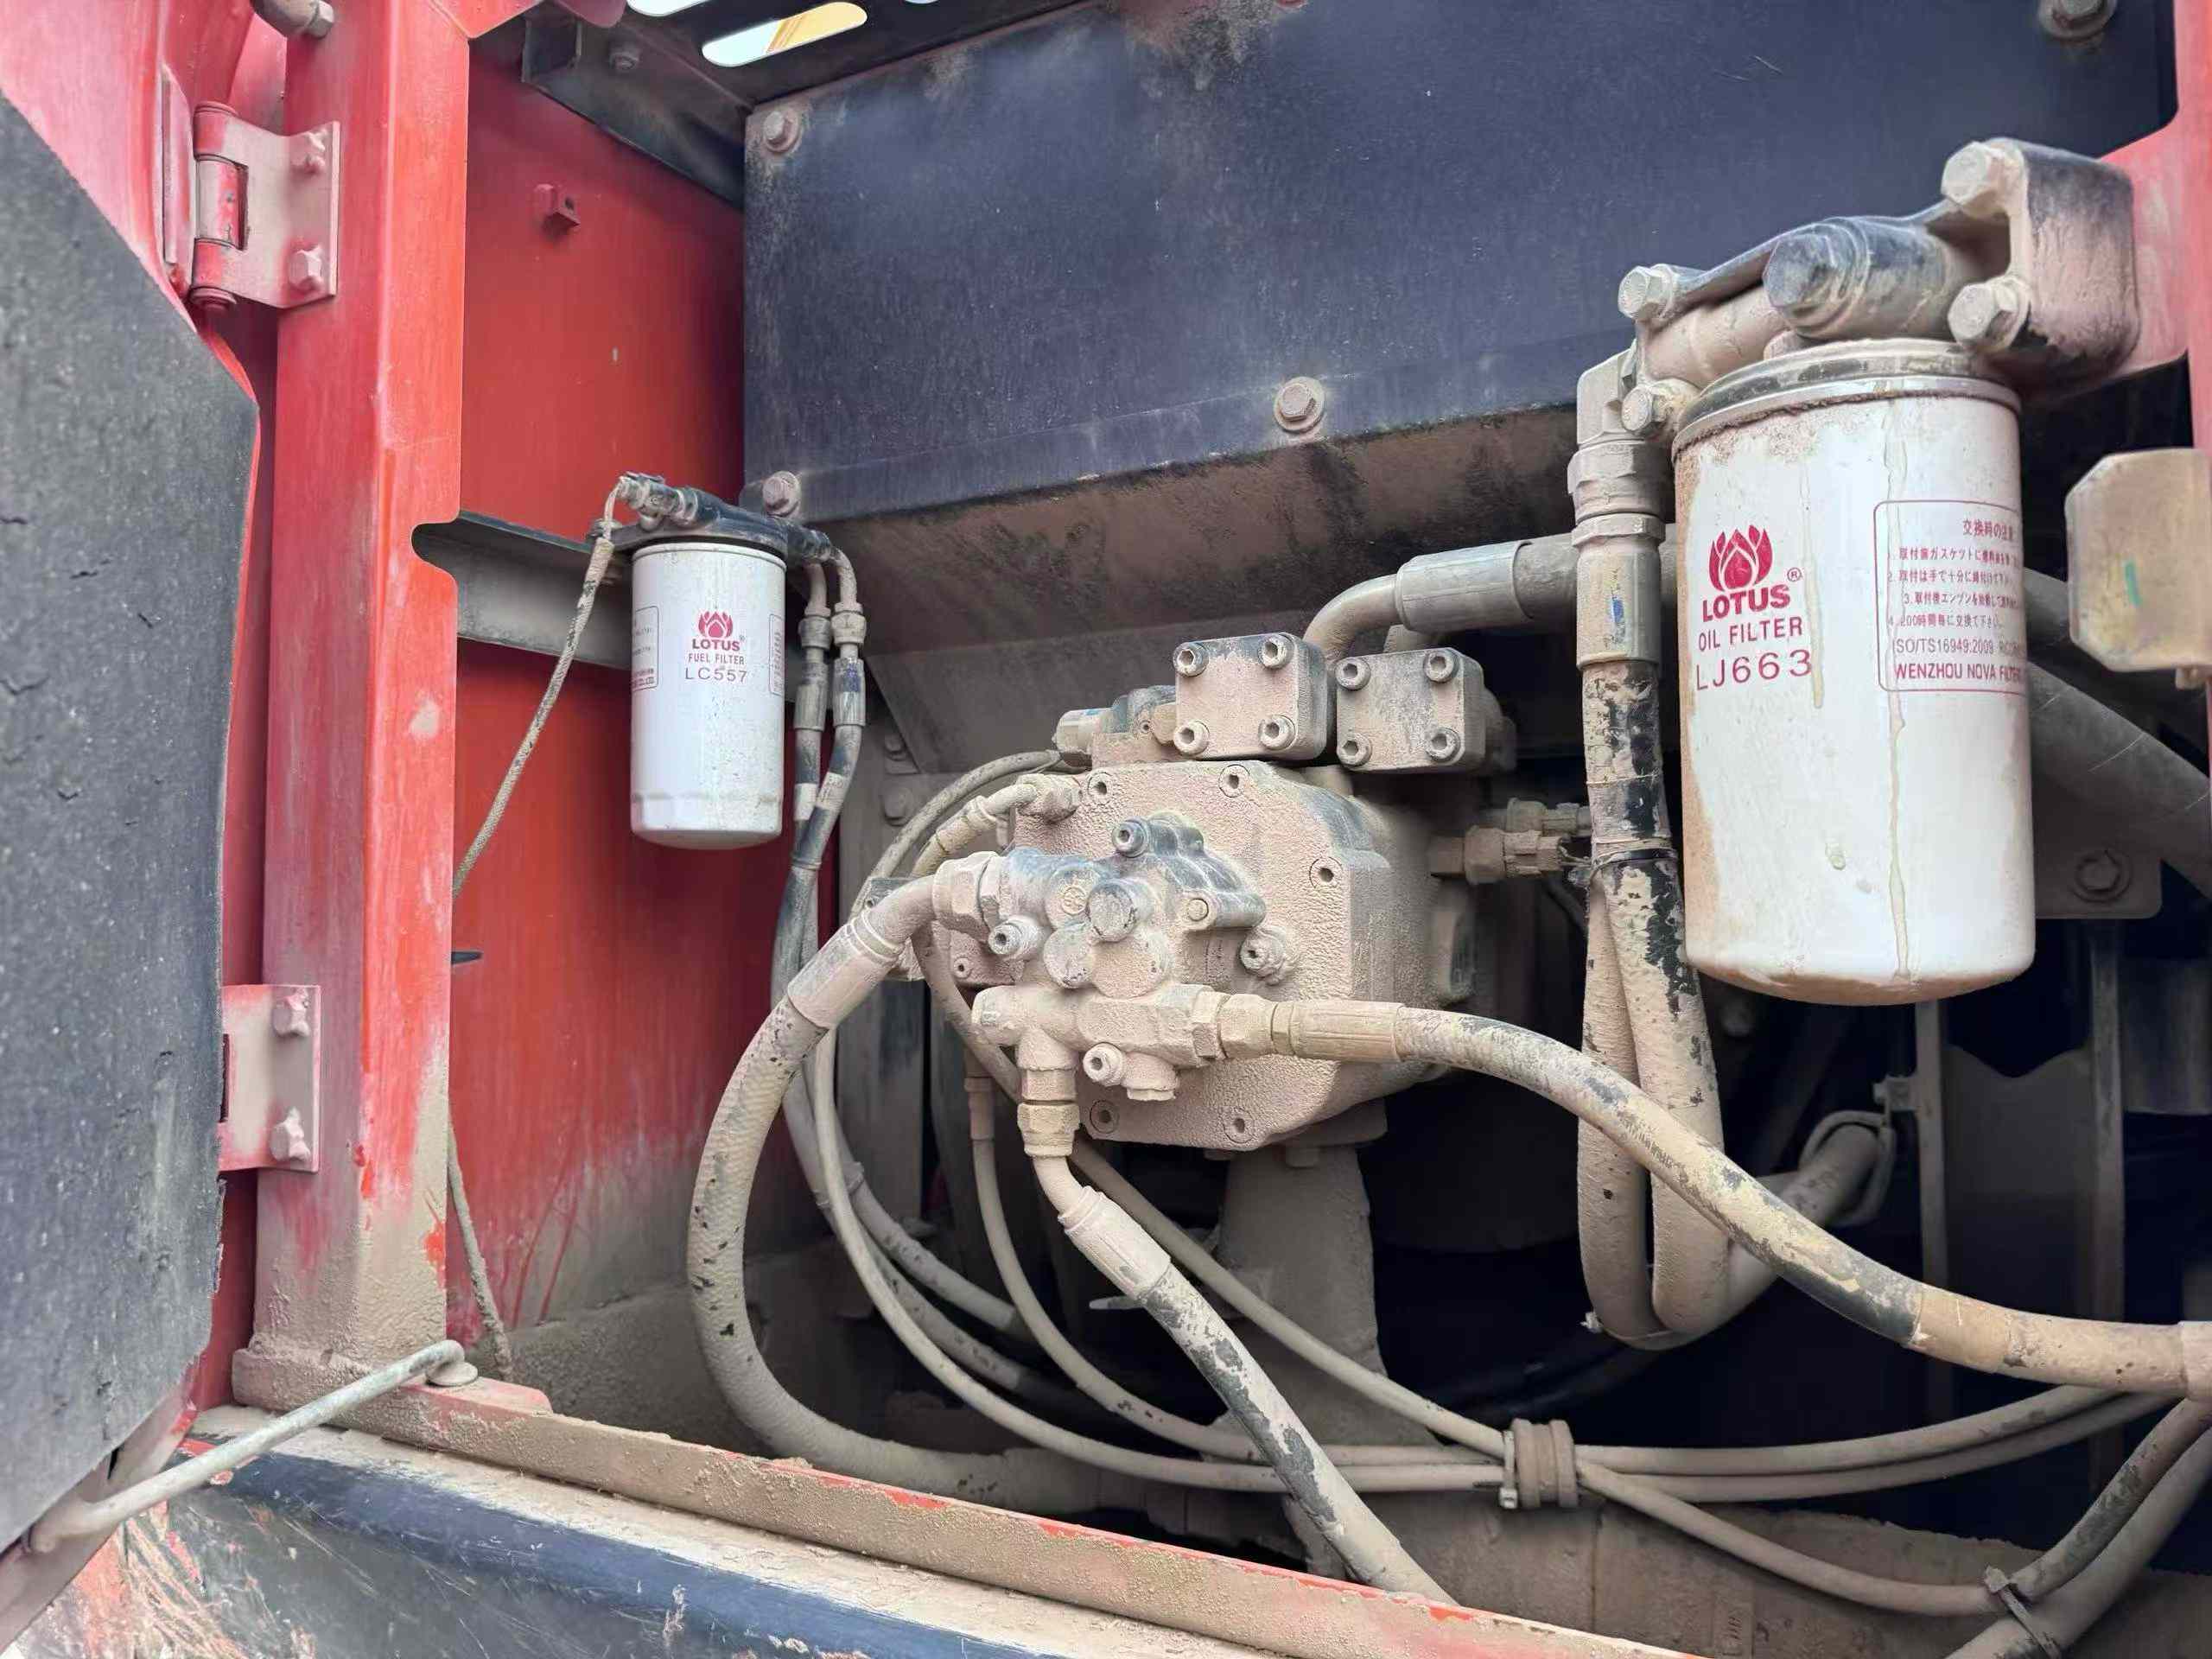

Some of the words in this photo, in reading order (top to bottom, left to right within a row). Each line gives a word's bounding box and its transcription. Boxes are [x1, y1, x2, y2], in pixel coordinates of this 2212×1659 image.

[1702, 584, 1790, 622] LOTUS
[1698, 629, 1720, 652] OIL
[1729, 616, 1803, 645] FILTER
[692, 639, 741, 652] LOTUS
[688, 652, 711, 664] FUEL
[715, 654, 745, 665] FILTER
[685, 667, 747, 683] LC557
[1696, 649, 1812, 691] LJ663
[1895, 663, 1962, 680] WENZHOU
[1967, 664, 1996, 680] NOVA
